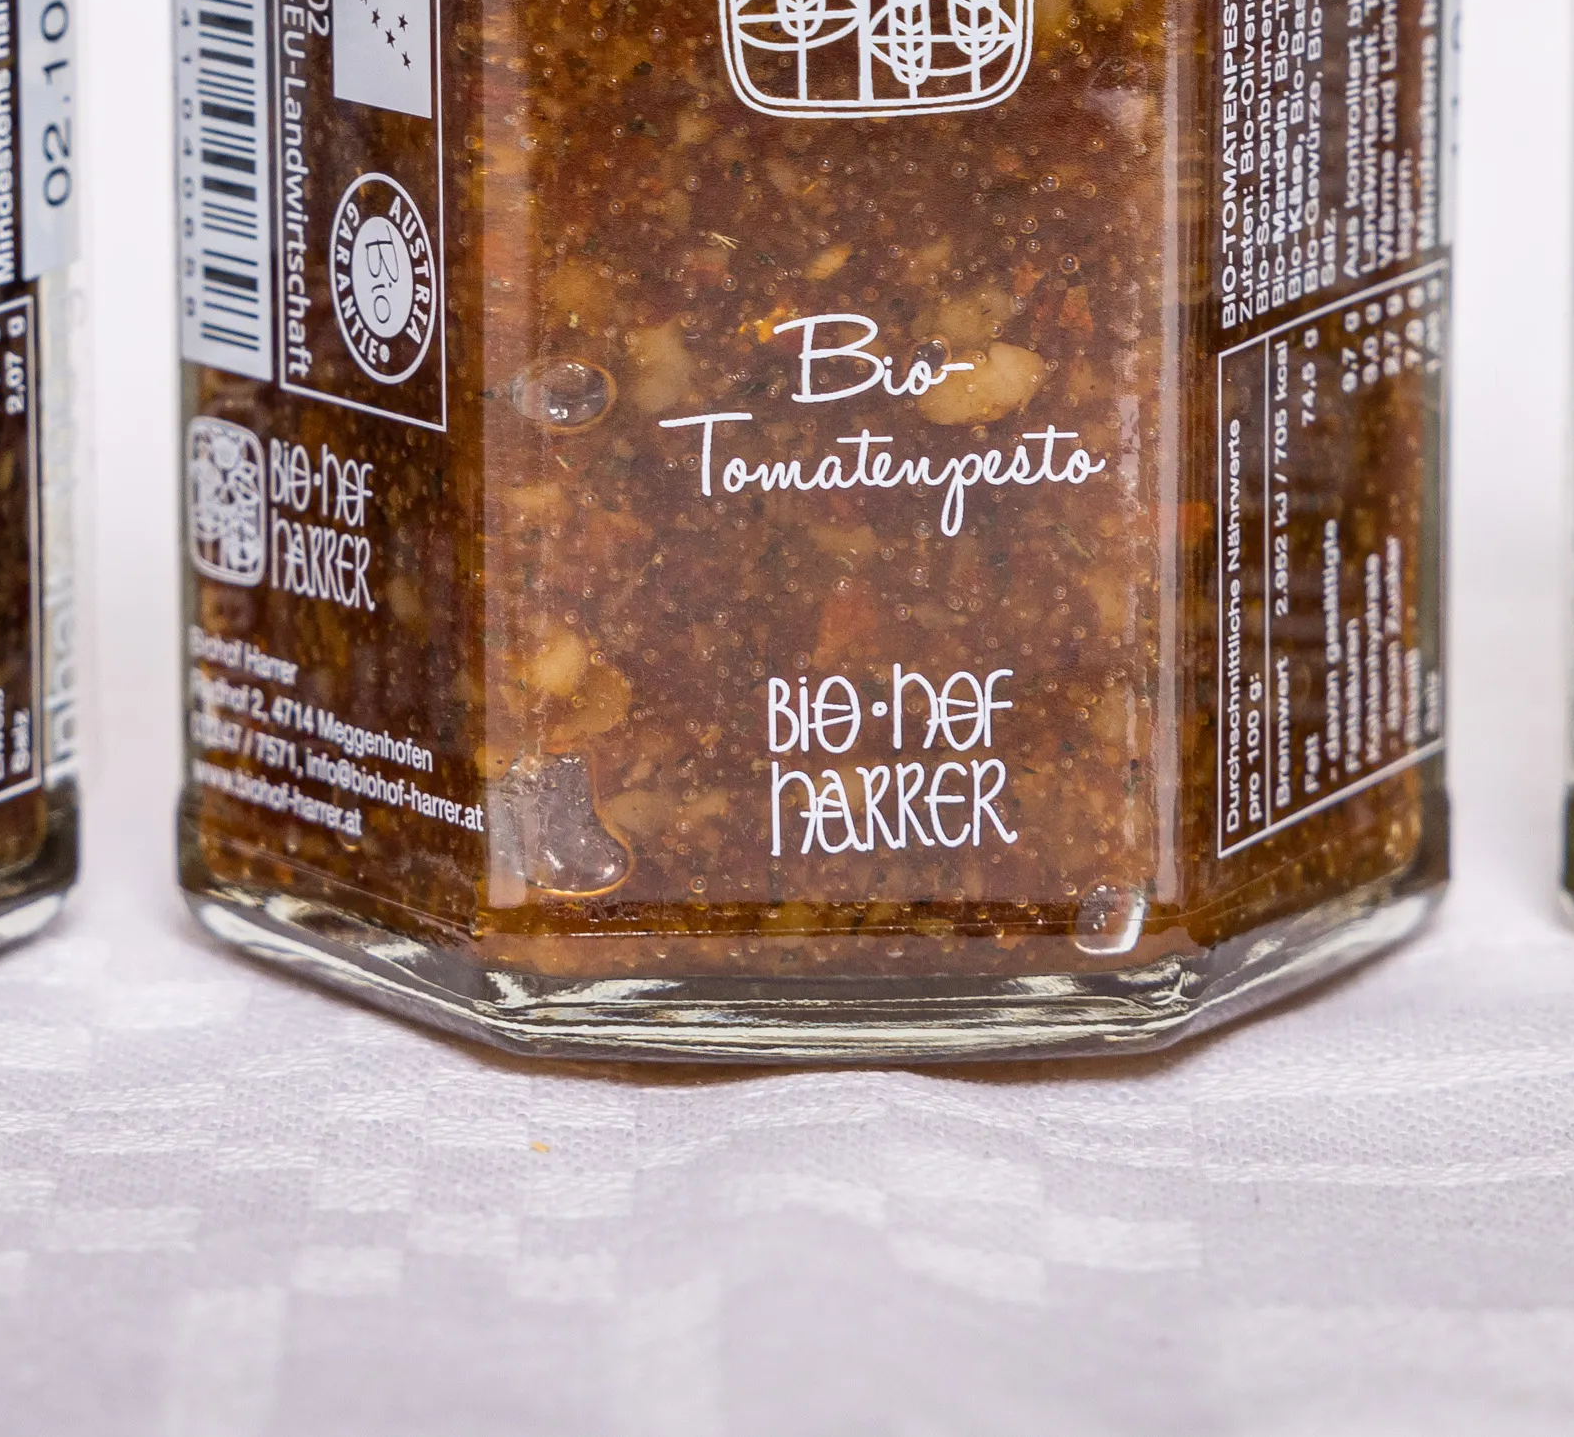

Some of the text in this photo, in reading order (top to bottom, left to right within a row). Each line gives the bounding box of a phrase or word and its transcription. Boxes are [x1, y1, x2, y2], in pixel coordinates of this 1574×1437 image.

[1344, 35, 1363, 208] kontrolliert
[1361, 25, 1379, 272] Landwirtschaft.
[1379, 80, 1397, 142] und
[1272, 90, 1290, 307] Bio-Mandeln,
[1288, 133, 1307, 299] Bio-Käse,
[1304, 71, 1323, 292] Bio-Gewürze,
[1378, 150, 1397, 264] Wärme
[364, 223, 399, 324] Bio
[388, 197, 431, 340] AUSTRIA
[1240, 185, 1256, 322] Zutaten:
[1321, 208, 1337, 287] Salz.
[1344, 215, 1361, 278] Aus
[773, 313, 975, 404] Bio-
[1274, 340, 1290, 400] kcal
[658, 412, 1106, 537] Tomatenpesto
[1274, 491, 1290, 526] kJ
[270, 507, 375, 612] HARRER
[244, 642, 299, 687] Harrer
[1225, 419, 1243, 832] Durchschnittliche Nährwerte
[1322, 519, 1341, 760] davon gesättigte
[254, 728, 303, 779] 7571,
[306, 747, 484, 833] info@biohof-harrer.at
[271, 694, 315, 732] 4714
[318, 706, 434, 773] Meggenhofen
[1246, 673, 1264, 822] pro 100 g:
[1274, 655, 1292, 807] Brennwert
[1304, 732, 1321, 792] Fett
[771, 758, 1018, 856] HARRER
